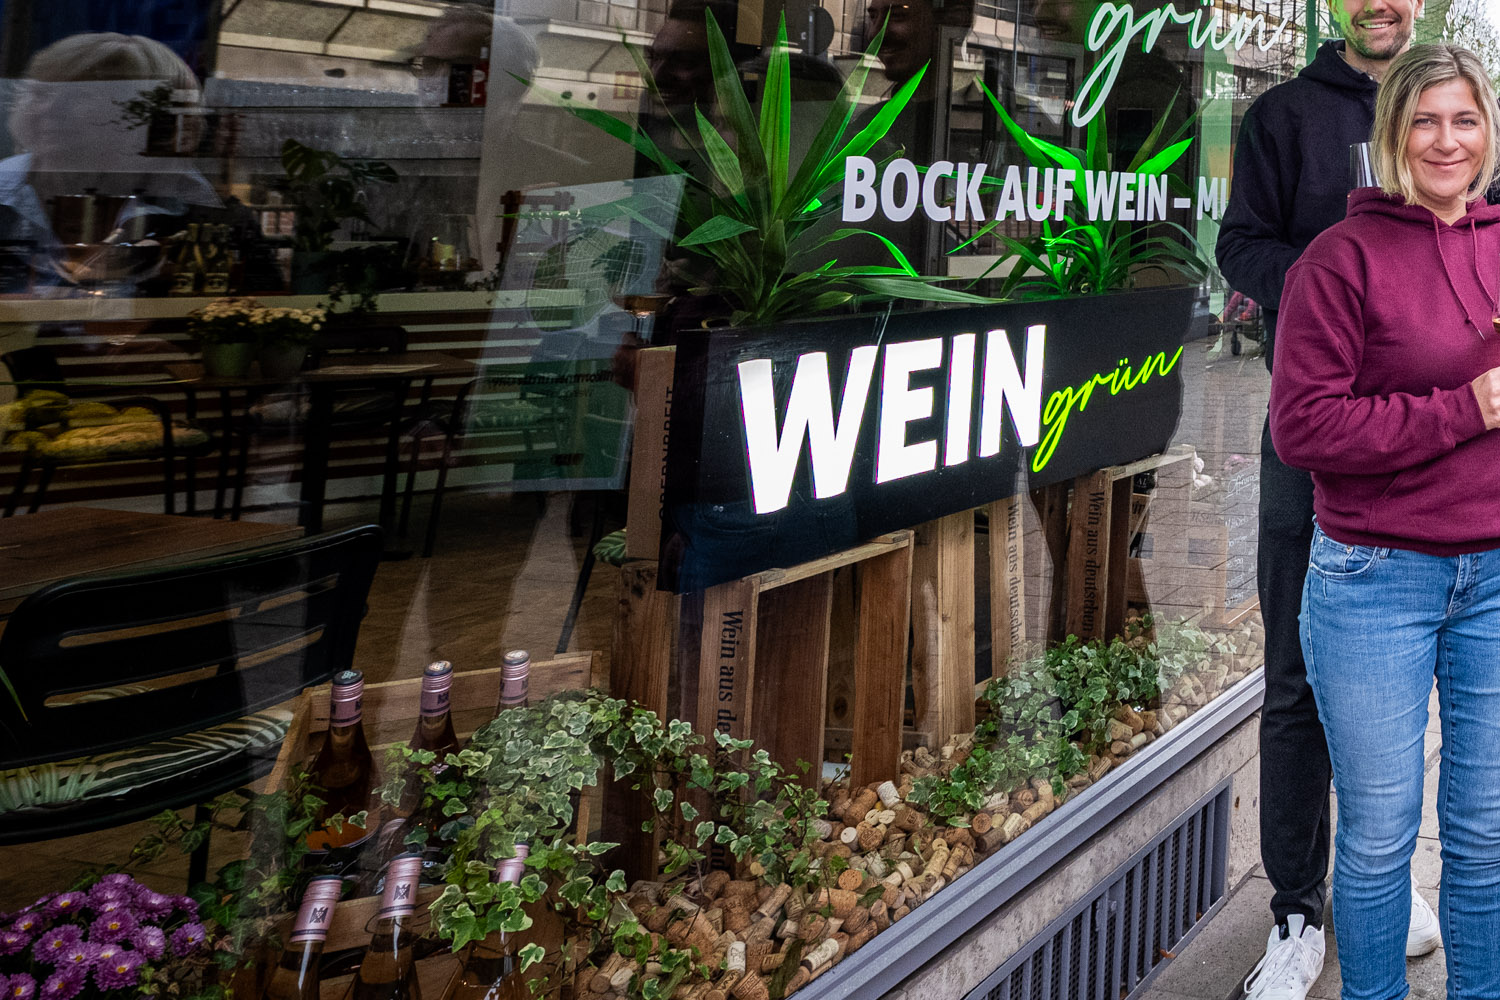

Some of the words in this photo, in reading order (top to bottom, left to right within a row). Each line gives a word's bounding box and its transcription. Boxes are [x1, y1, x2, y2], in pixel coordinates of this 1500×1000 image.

[842, 155, 988, 222] BOCK
[996, 165, 1077, 222] AUF
[1085, 169, 1168, 222] WEIN
[737, 323, 1047, 514] WEIN
[1032, 344, 1185, 473] grün
[1007, 503, 1021, 541] Wein
[1088, 491, 1105, 525] Wein
[1008, 544, 1018, 572] aus
[1086, 529, 1099, 556] aus
[1083, 559, 1101, 633] deutschen
[720, 609, 743, 659] Wein
[717, 665, 735, 702] aus
